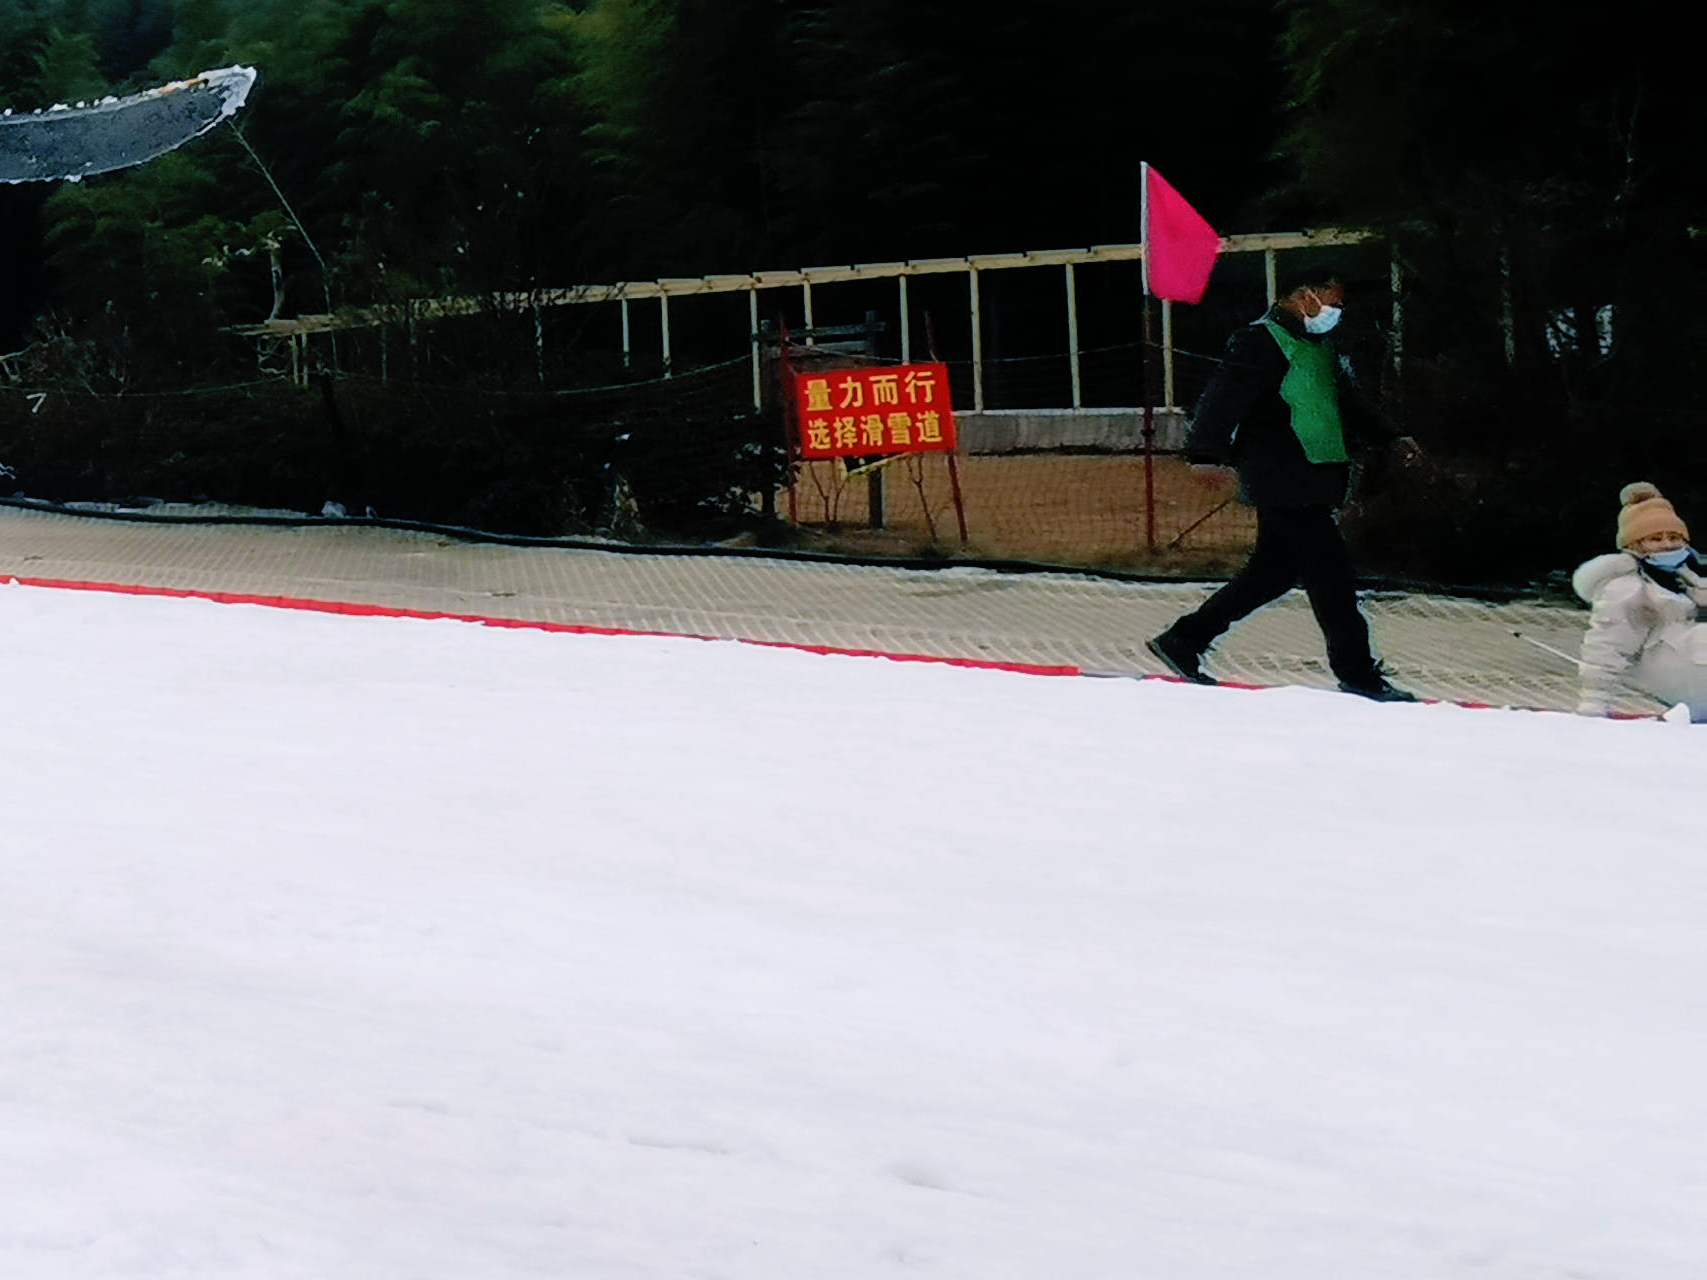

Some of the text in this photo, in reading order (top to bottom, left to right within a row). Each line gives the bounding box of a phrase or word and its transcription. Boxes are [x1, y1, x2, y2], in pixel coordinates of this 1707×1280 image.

[804, 370, 936, 412] 量力而行
[807, 409, 943, 450] 选择滑雪道
